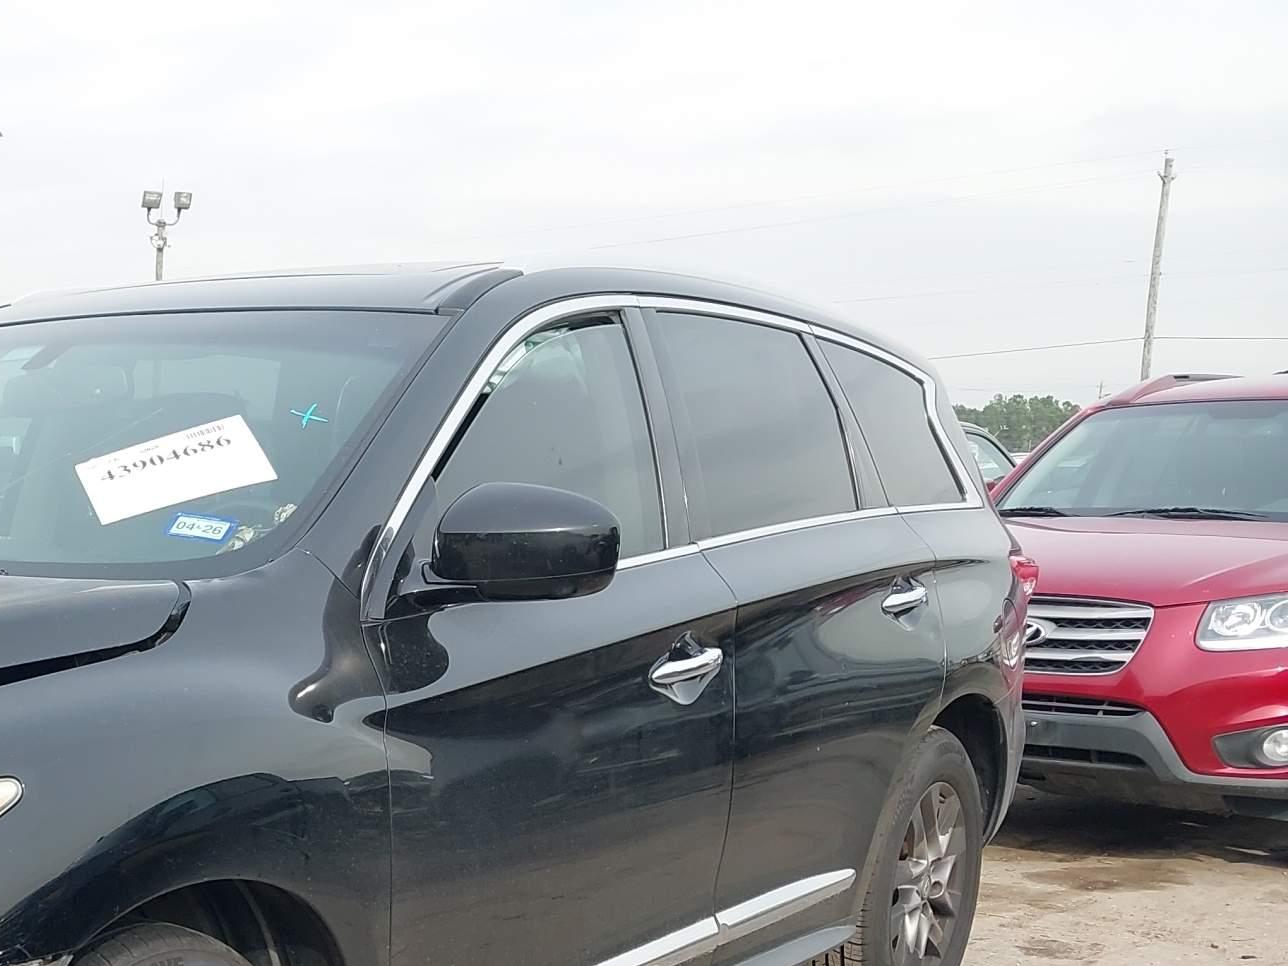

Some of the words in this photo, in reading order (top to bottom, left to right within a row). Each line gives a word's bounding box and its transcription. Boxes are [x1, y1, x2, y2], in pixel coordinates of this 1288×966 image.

[100, 434, 232, 482] 43904686
[175, 520, 197, 531] 04
[201, 524, 224, 535] 26
